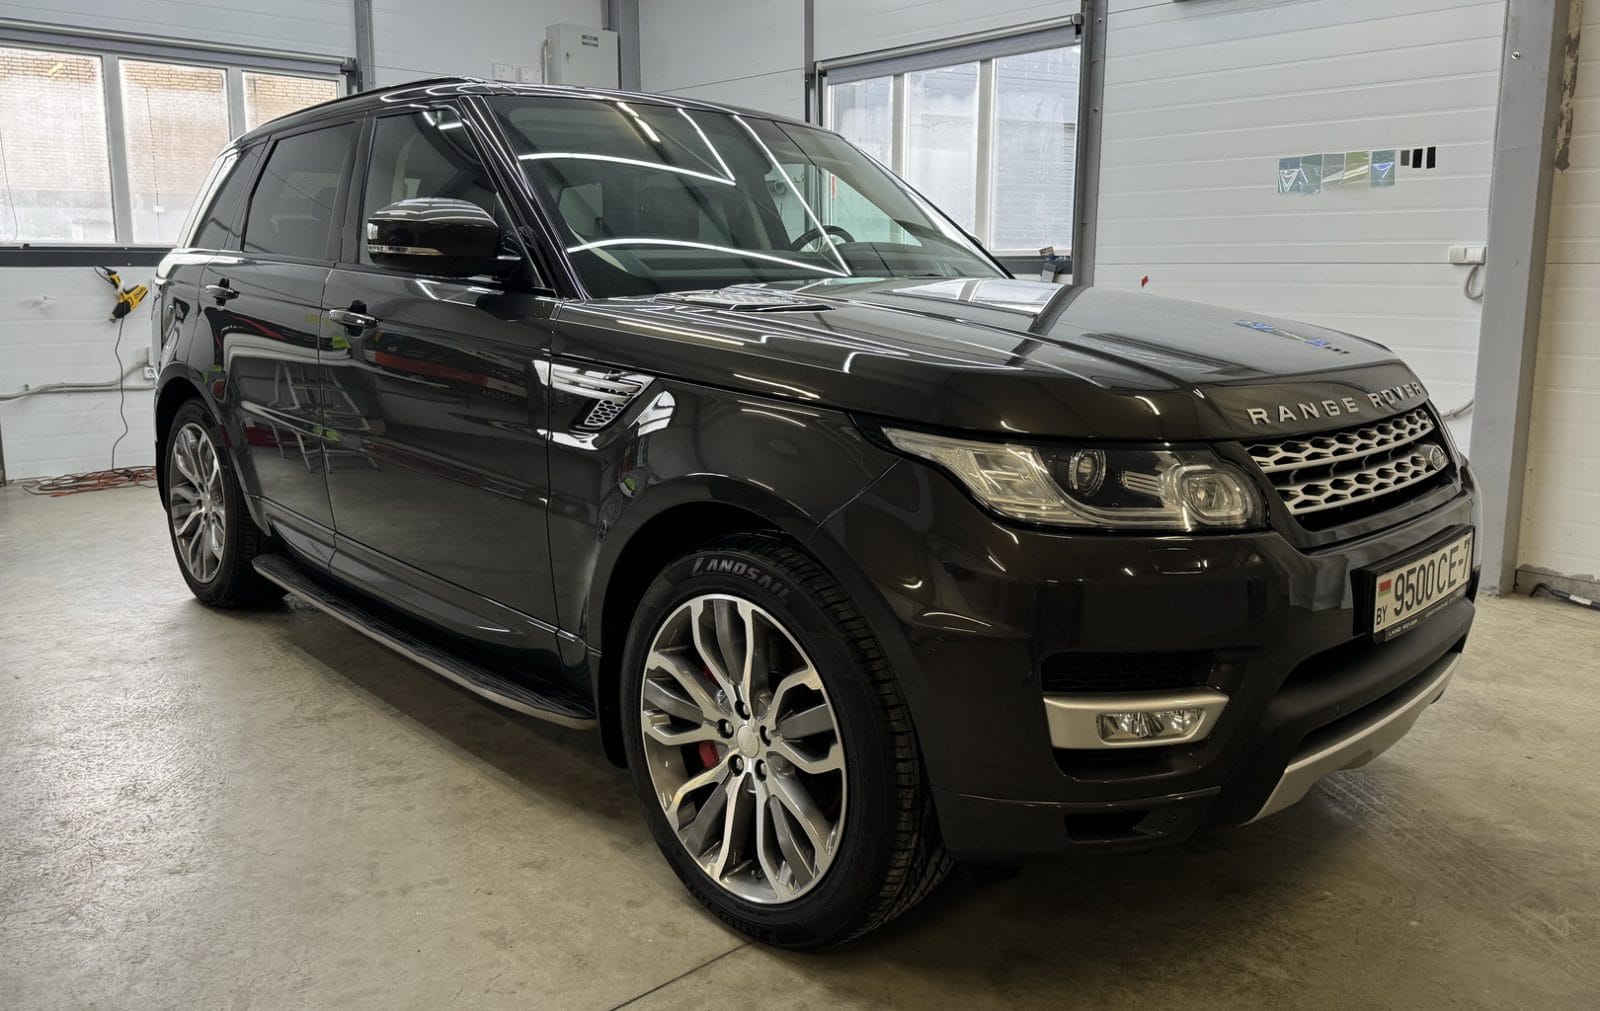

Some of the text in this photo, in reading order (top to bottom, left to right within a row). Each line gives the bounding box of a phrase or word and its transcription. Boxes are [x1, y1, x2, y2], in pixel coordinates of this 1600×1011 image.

[1246, 382, 1421, 425] RANGE ROVER
[692, 557, 790, 600] LANDSAIL
[1375, 604, 1388, 626] BY
